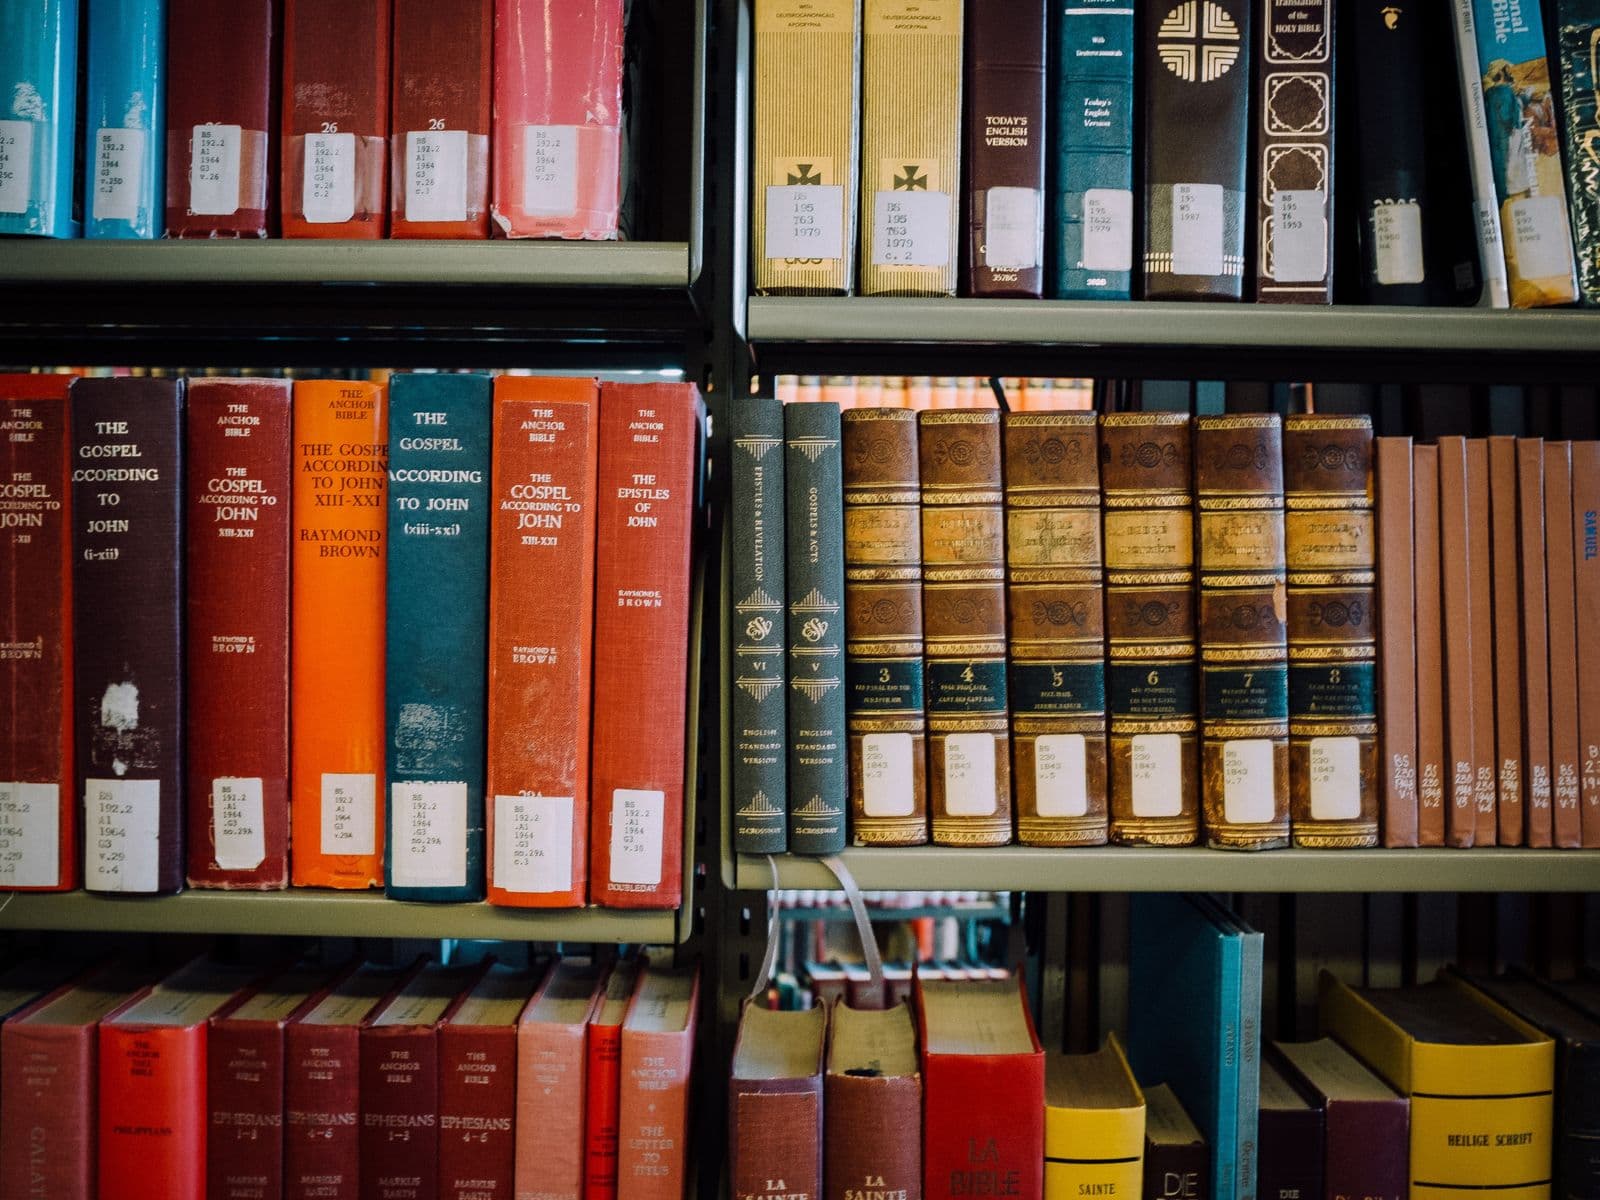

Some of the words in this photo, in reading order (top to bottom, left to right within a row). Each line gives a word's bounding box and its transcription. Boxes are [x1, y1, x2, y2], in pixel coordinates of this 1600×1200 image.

[1288, 11, 1296, 20] of
[1296, 12, 1308, 20] the
[1276, 24, 1296, 32] HOLY
[1298, 24, 1321, 32] BIBLE
[1084, 99, 1111, 107] Today's
[1084, 109, 1109, 117] English
[429, 119, 445, 130] 26
[985, 117, 1027, 125] TODAY'S
[321, 123, 338, 133] 26
[986, 127, 1027, 135] ENGLISH
[985, 138, 1027, 146] VERSION
[794, 204, 814, 212] 195
[887, 215, 907, 223] 195
[794, 228, 821, 236] 1979
[886, 227, 907, 235] T63
[886, 239, 913, 247] 1979
[340, 390, 362, 398] THE
[228, 405, 247, 413] THE
[329, 401, 374, 409] ANCHOR
[11, 409, 31, 417] THE
[336, 412, 367, 420] BIBLE
[532, 409, 553, 417] THE
[217, 416, 260, 425] ANCHOR
[413, 413, 447, 424] THE
[1, 421, 43, 429] ANCHOR
[95, 422, 128, 434] THE
[521, 422, 565, 430] ANCHOR
[225, 428, 250, 437] BIBLE
[10, 434, 34, 442] BIBLE
[529, 434, 555, 442] BIBLE
[400, 438, 462, 450] GOSPEL
[80, 446, 141, 458] GOSPEL
[302, 444, 332, 456] THE
[13, 473, 31, 481] THE
[72, 469, 159, 481] CCORDING
[226, 468, 246, 476] THE
[530, 474, 551, 482] THE
[632, 475, 656, 484] THE
[208, 480, 267, 493] GOSPEL
[312, 477, 332, 489] TO
[340, 478, 383, 491] JOHN
[754, 466, 763, 510] EPISTLES
[511, 486, 571, 500] GOSPEL
[618, 489, 669, 499] EPISTLES
[98, 494, 119, 505] TO
[199, 496, 258, 504] ACCORDING
[261, 496, 276, 505] TO
[315, 495, 380, 506] XIII-XXI
[397, 498, 419, 510] TO
[426, 499, 468, 510] JOHN
[501, 502, 562, 511] ACCORDING
[565, 504, 581, 512] TO
[635, 503, 651, 512] OF
[810, 487, 818, 529] GOSPELS
[215, 508, 258, 521] JOHN
[0, 514, 42, 527] JOHN
[518, 515, 562, 529] JOHN
[627, 517, 657, 527] JOHN
[88, 521, 128, 533] JOHN
[404, 524, 460, 535] (xiii-xxi)
[219, 528, 253, 537] XIII-XXI
[300, 530, 381, 541] RAYMOND
[1585, 512, 1597, 560] SAMUEL
[521, 536, 557, 545] XIII-XXI
[85, 549, 118, 560] (i-xii)
[320, 546, 380, 557] BROWN
[755, 520, 763, 581] REVELATION
[810, 540, 818, 563] ACTS
[618, 598, 661, 607] BROWN
[213, 644, 254, 653] BROWN
[513, 655, 557, 664] BROWN
[812, 663, 820, 671] V
[880, 669, 890, 682] 3
[961, 667, 974, 682] 4
[1053, 672, 1062, 686] 5
[1147, 671, 1158, 685] 6
[1244, 673, 1253, 686] 7
[99, 804, 132, 813] 192.2
[99, 828, 125, 837] 1964
[98, 865, 118, 873] c.4
[213, 1113, 281, 1126] EPHESIANS
[289, 1114, 356, 1125] EPHESIANS
[365, 1115, 434, 1127] EPHESIANS
[441, 1118, 510, 1129] EPHESIANS
[1448, 1135, 1489, 1146] HEILIGE
[1496, 1133, 1532, 1145] SCHRIFT
[969, 1138, 999, 1163] LA
[767, 1180, 785, 1191] LA
[865, 1176, 884, 1186] LA
[950, 1171, 1021, 1195] BIBLE
[1164, 1173, 1197, 1196] DIE
[1079, 1184, 1115, 1195] SAINTE
[1280, 1190, 1299, 1199] DIE
[845, 1190, 907, 1200] SAINTE
